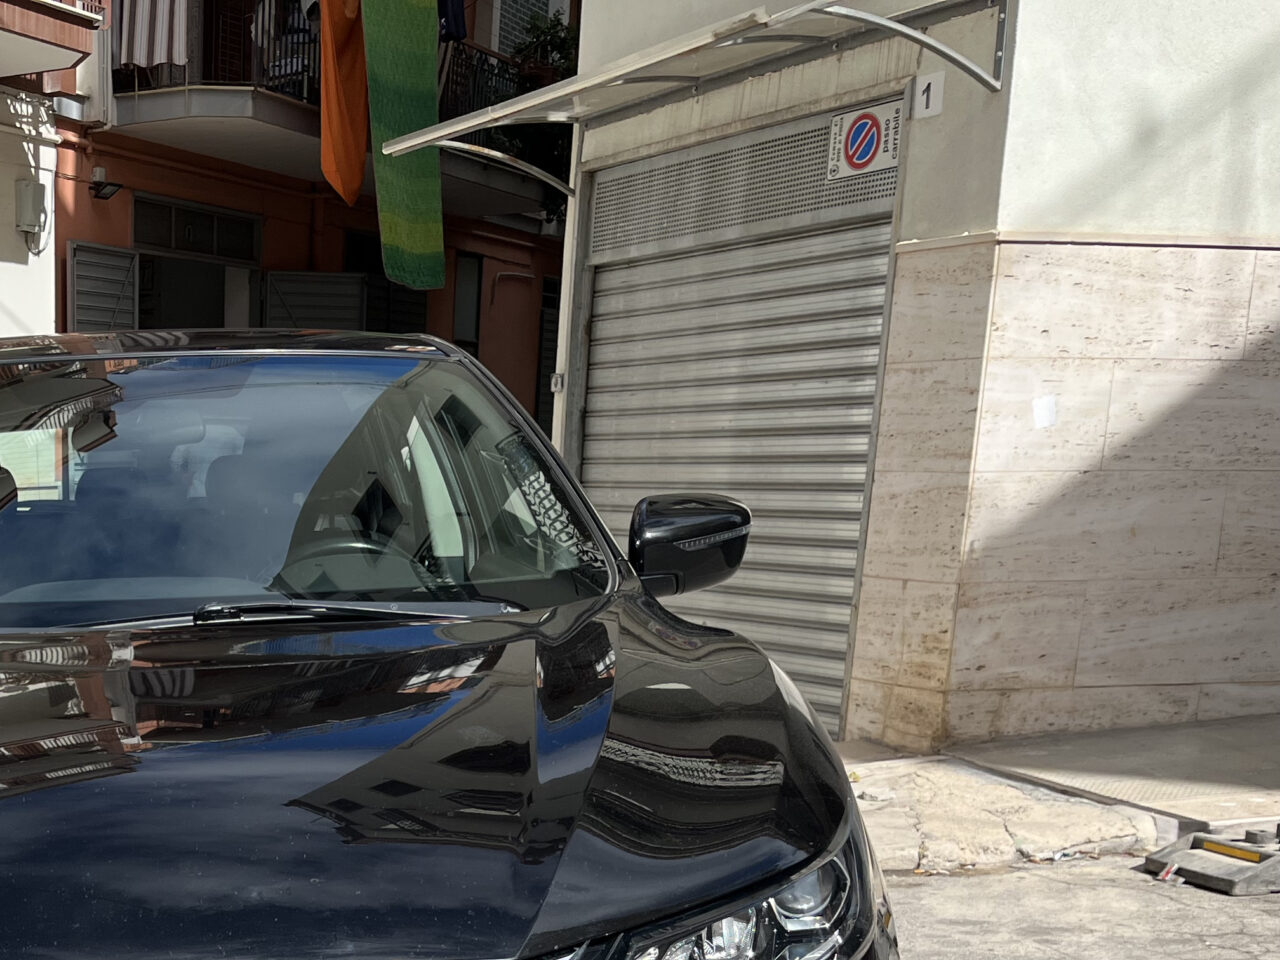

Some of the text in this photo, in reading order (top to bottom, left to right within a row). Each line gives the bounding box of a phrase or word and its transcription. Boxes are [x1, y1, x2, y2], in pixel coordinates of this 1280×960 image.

[921, 82, 932, 109] 1
[883, 118, 891, 153] passo
[892, 107, 901, 160] carrabile
